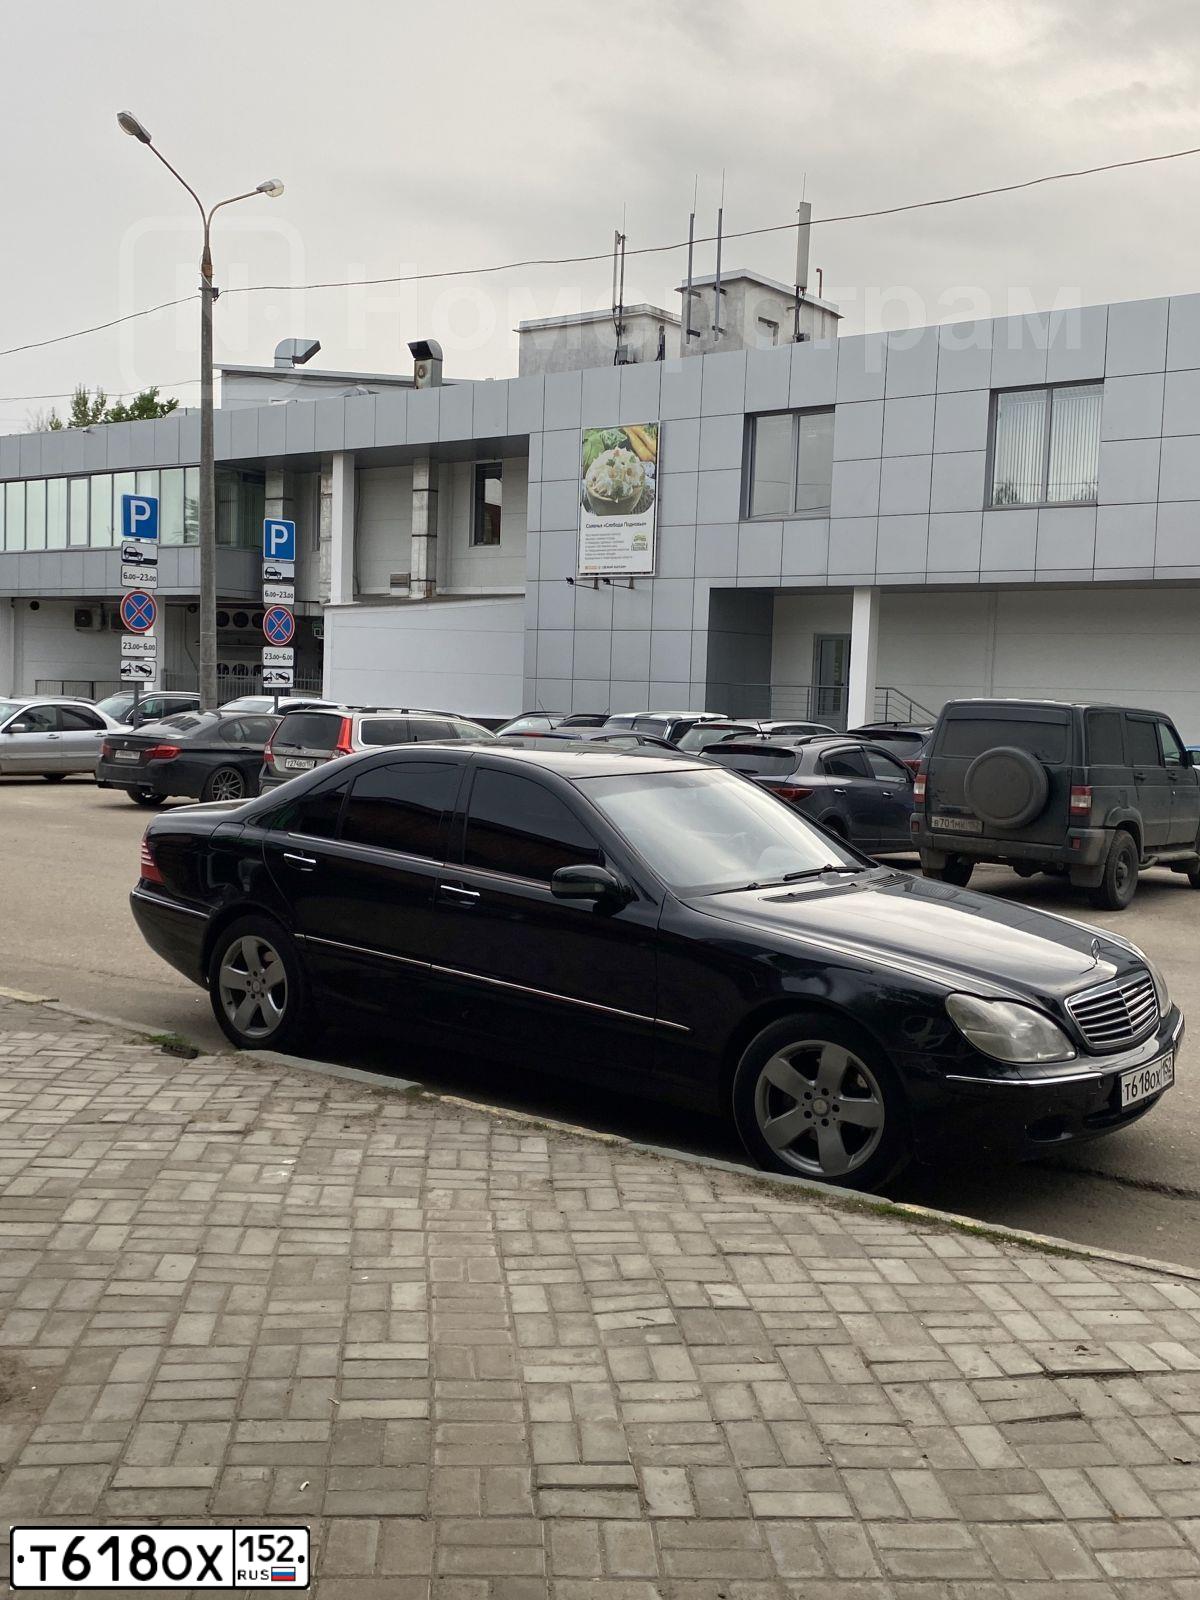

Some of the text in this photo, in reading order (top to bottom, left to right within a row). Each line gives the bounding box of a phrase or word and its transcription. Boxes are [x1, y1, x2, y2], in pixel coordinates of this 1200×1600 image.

[130, 499, 151, 533] P
[270, 524, 289, 555] P
[122, 571, 157, 582] 6.00-23.00
[264, 590, 294, 600] 6.00-23.00
[122, 642, 156, 651] 23.00-6.00
[264, 652, 293, 661] 23.00-6.00
